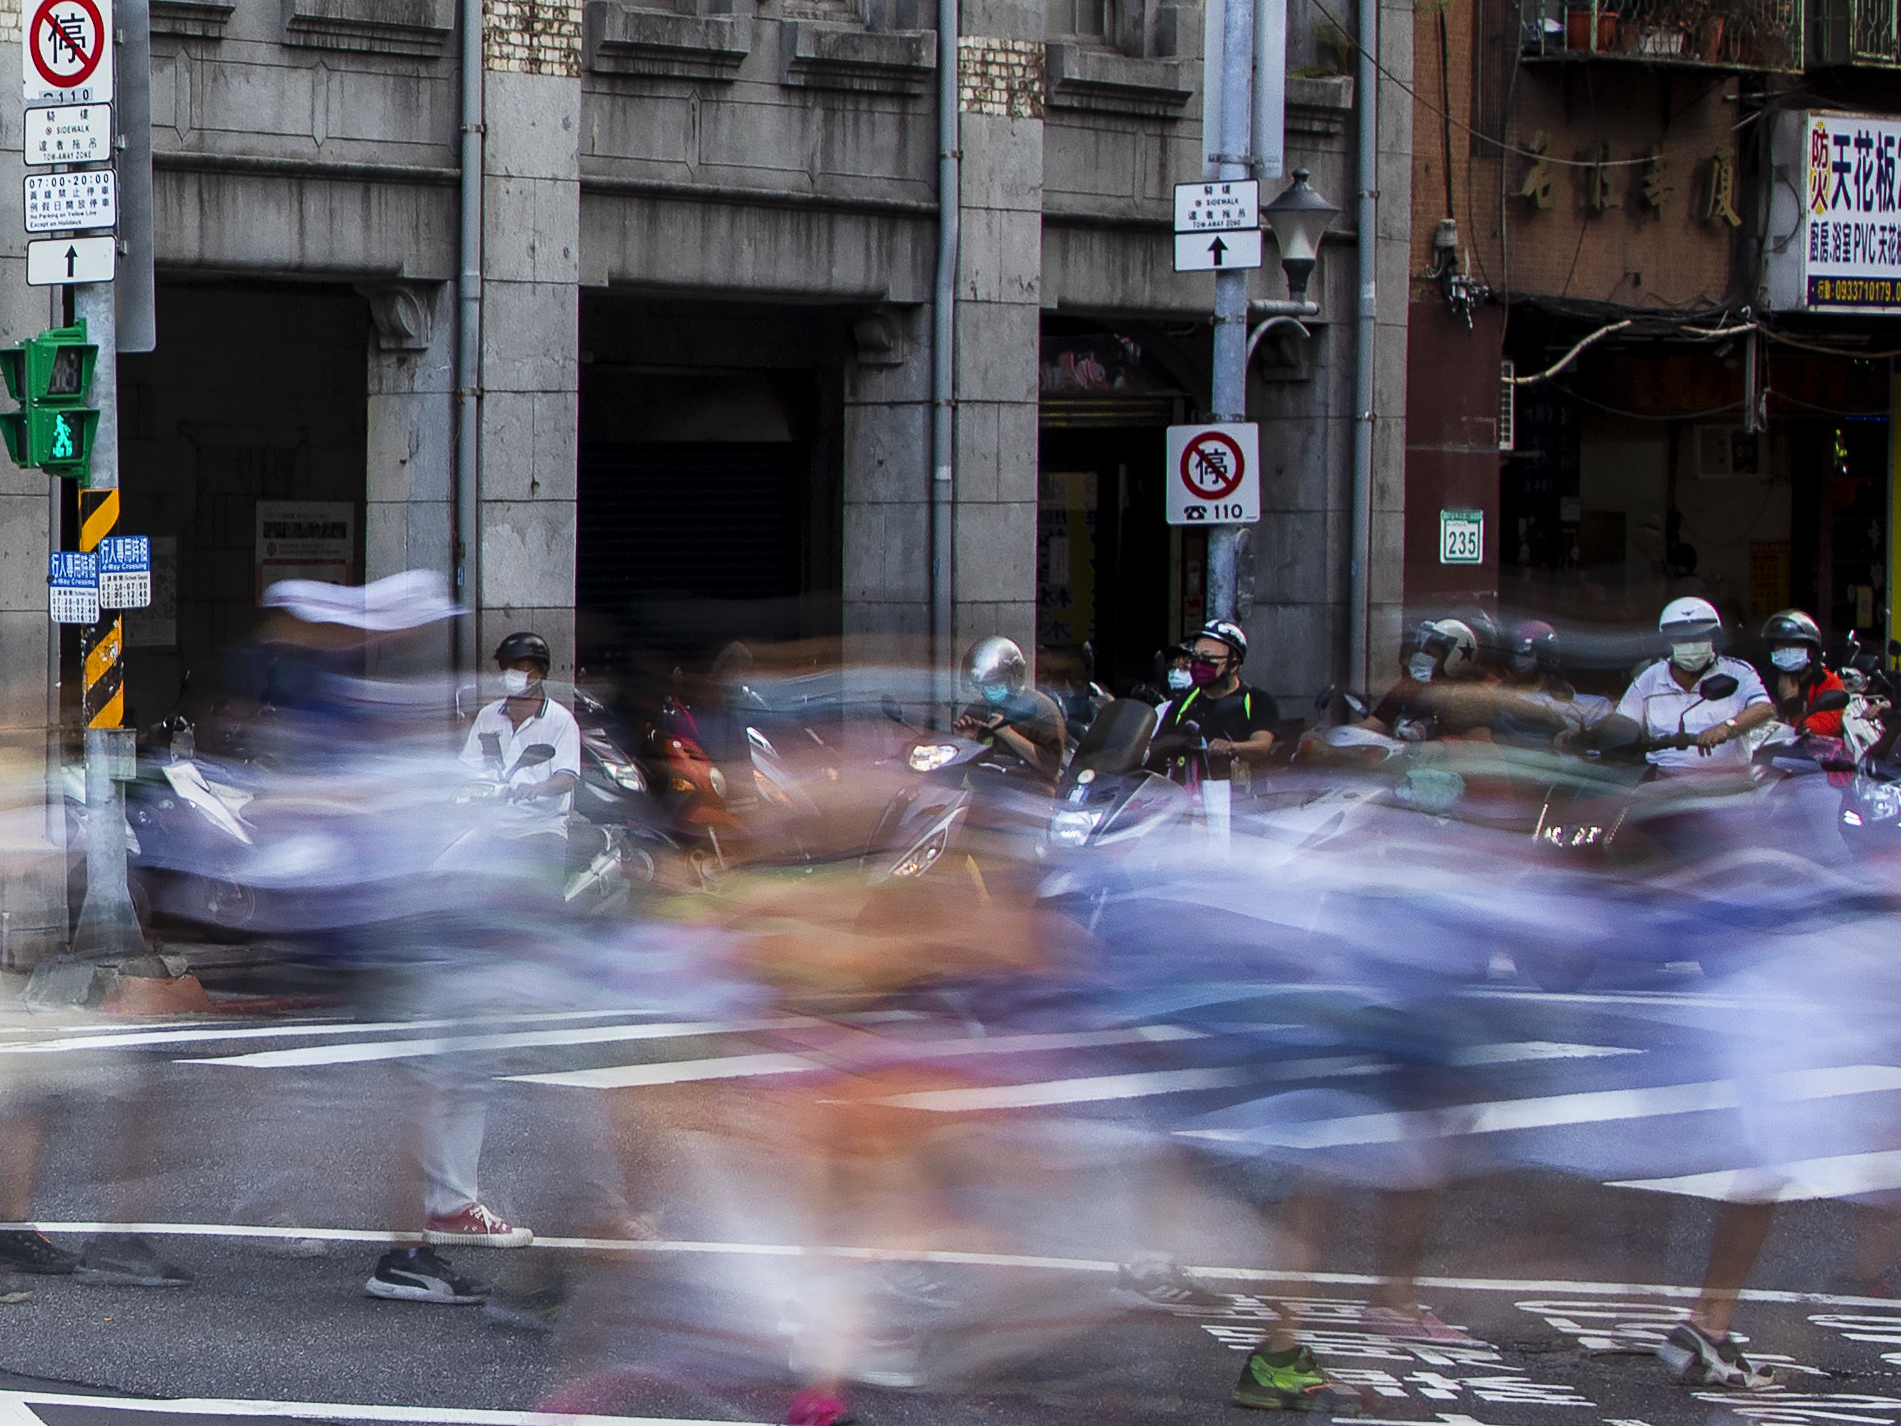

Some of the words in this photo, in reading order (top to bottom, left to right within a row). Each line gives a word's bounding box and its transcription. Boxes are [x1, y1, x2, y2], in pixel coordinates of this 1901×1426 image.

[48, 12, 87, 64] 停
[59, 88, 90, 103] 110
[56, 125, 90, 134] SIDEWALK
[1811, 129, 1828, 210] 防火
[1832, 130, 1901, 213] 天花板
[29, 173, 109, 189] 07:00-20:00
[1214, 504, 1242, 519] 110
[1449, 531, 1476, 555] 235
